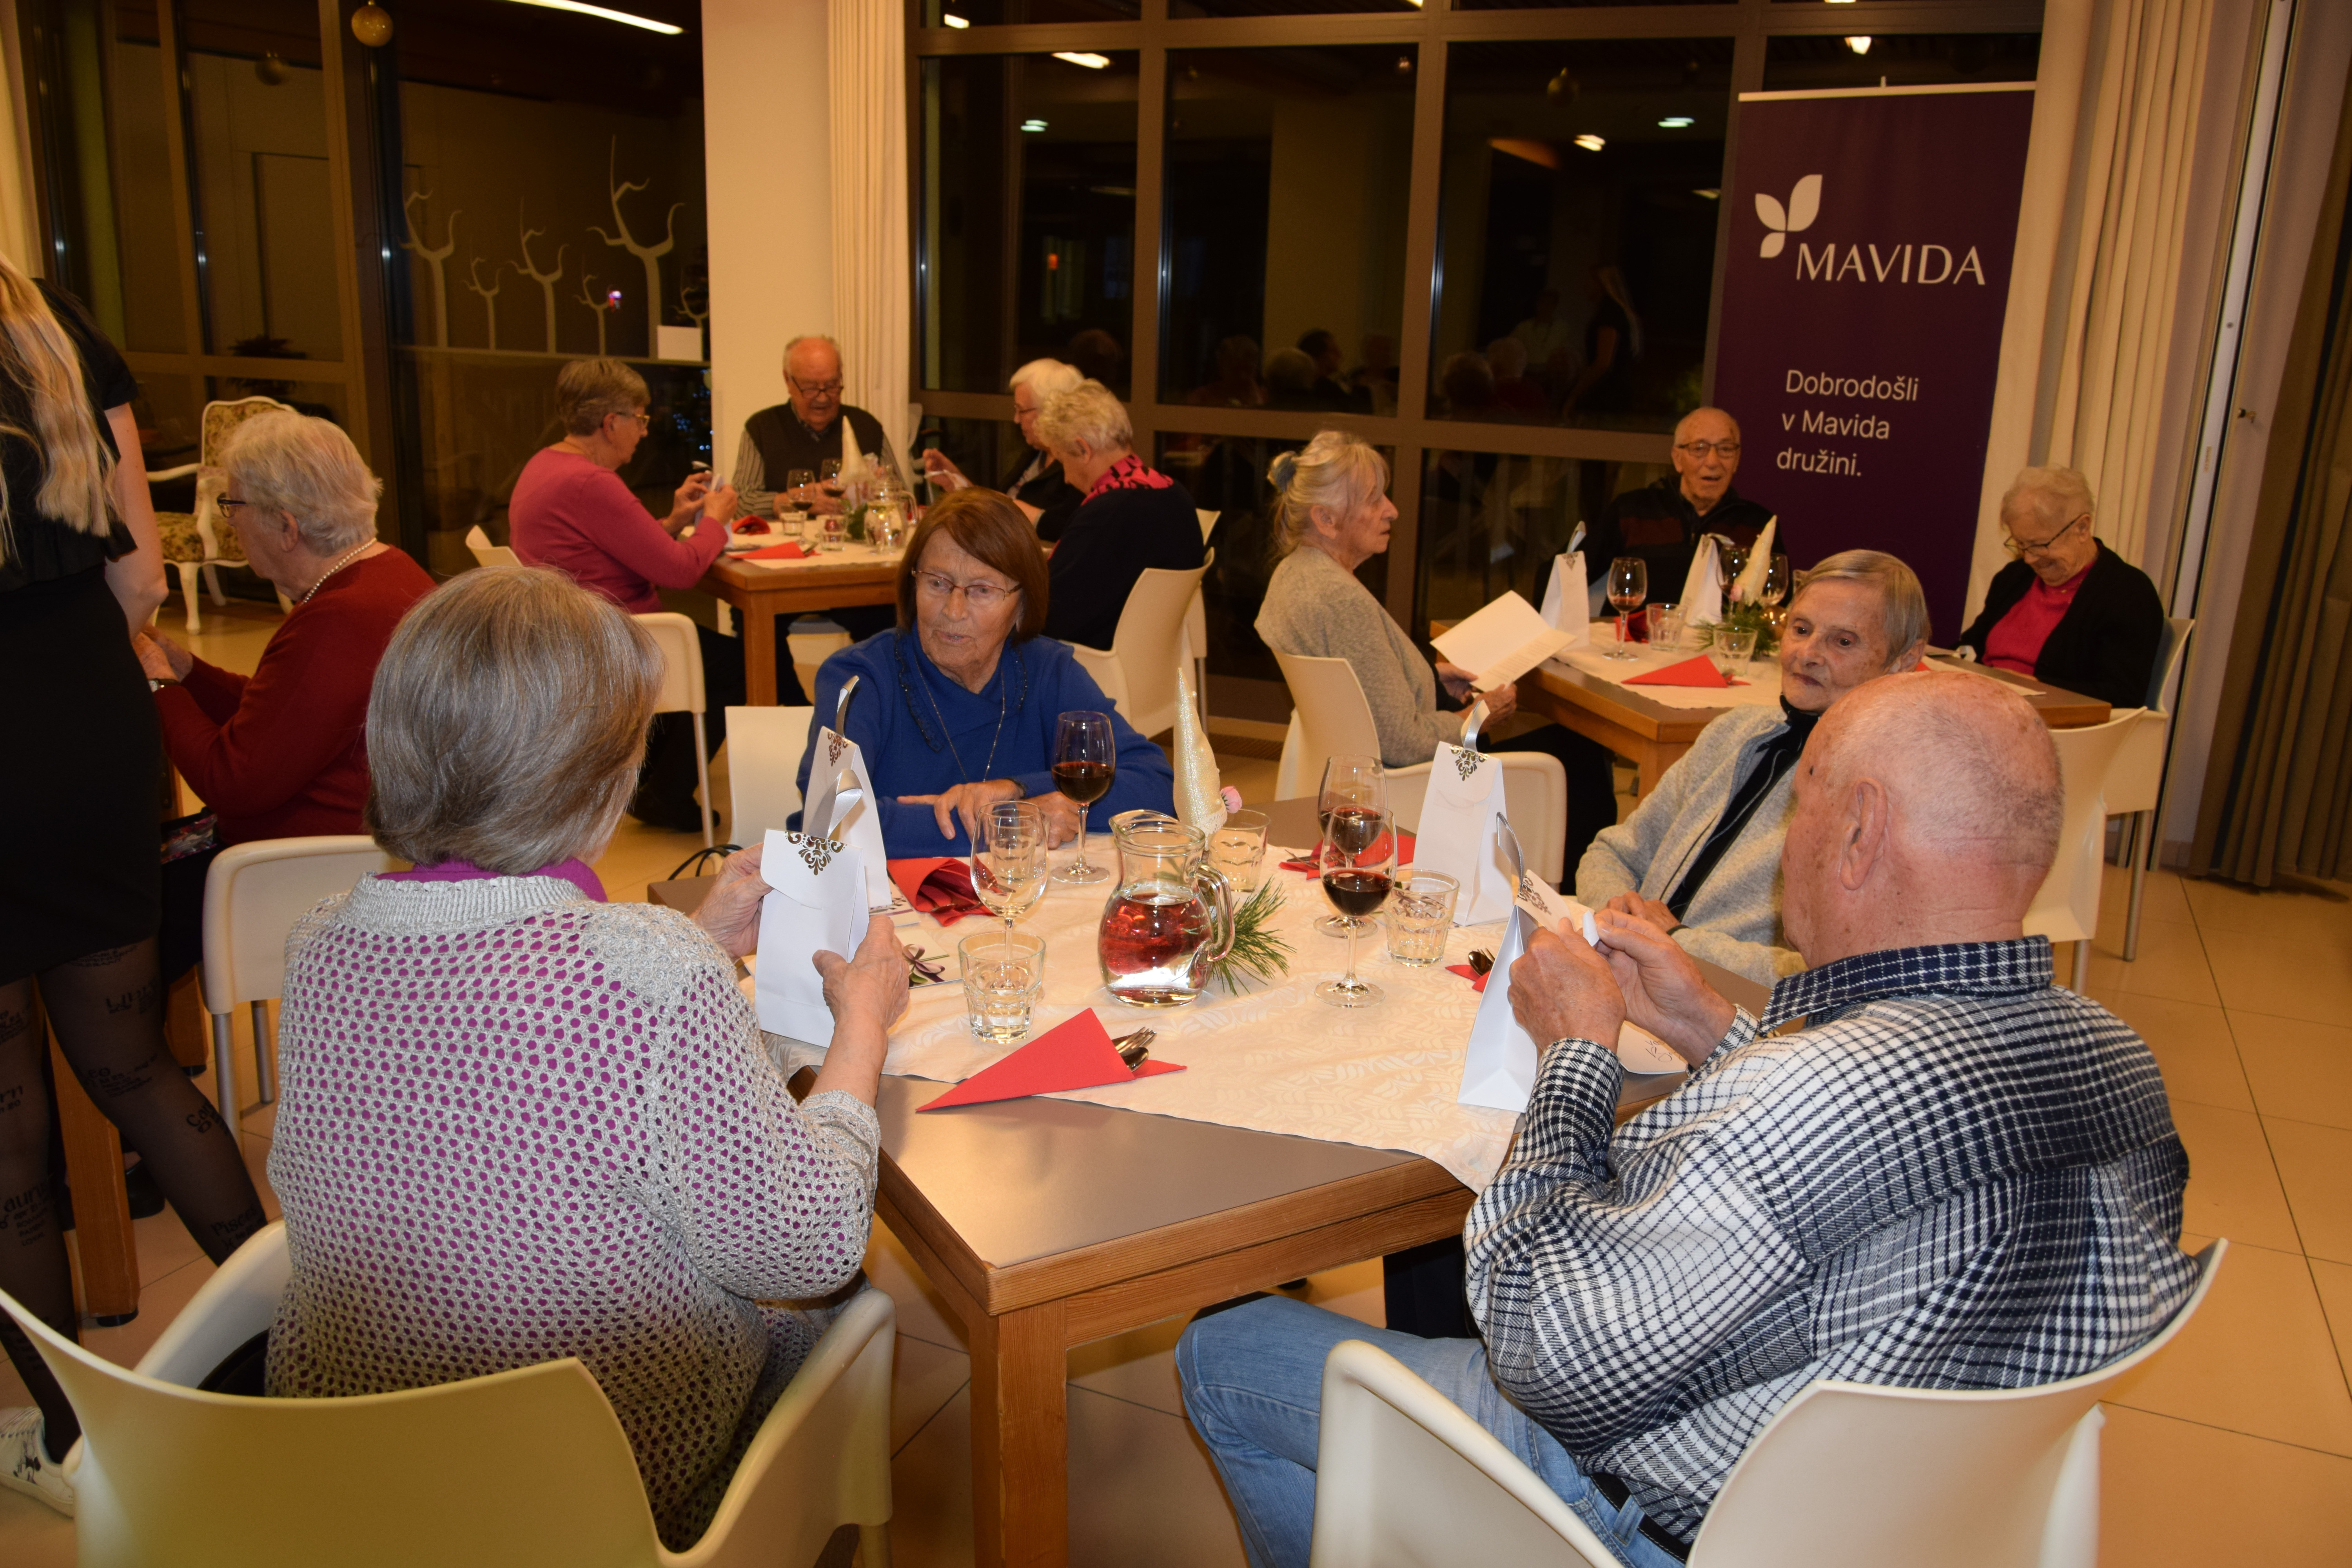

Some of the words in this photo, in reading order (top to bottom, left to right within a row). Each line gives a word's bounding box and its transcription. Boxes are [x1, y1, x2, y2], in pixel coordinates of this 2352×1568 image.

[1796, 243, 1985, 285] MAVIDA
[1786, 369, 1919, 401] Dobrodošli
[1782, 413, 1795, 431] v
[1802, 410, 1890, 439] Mavida
[1777, 447, 1862, 477] družini.
